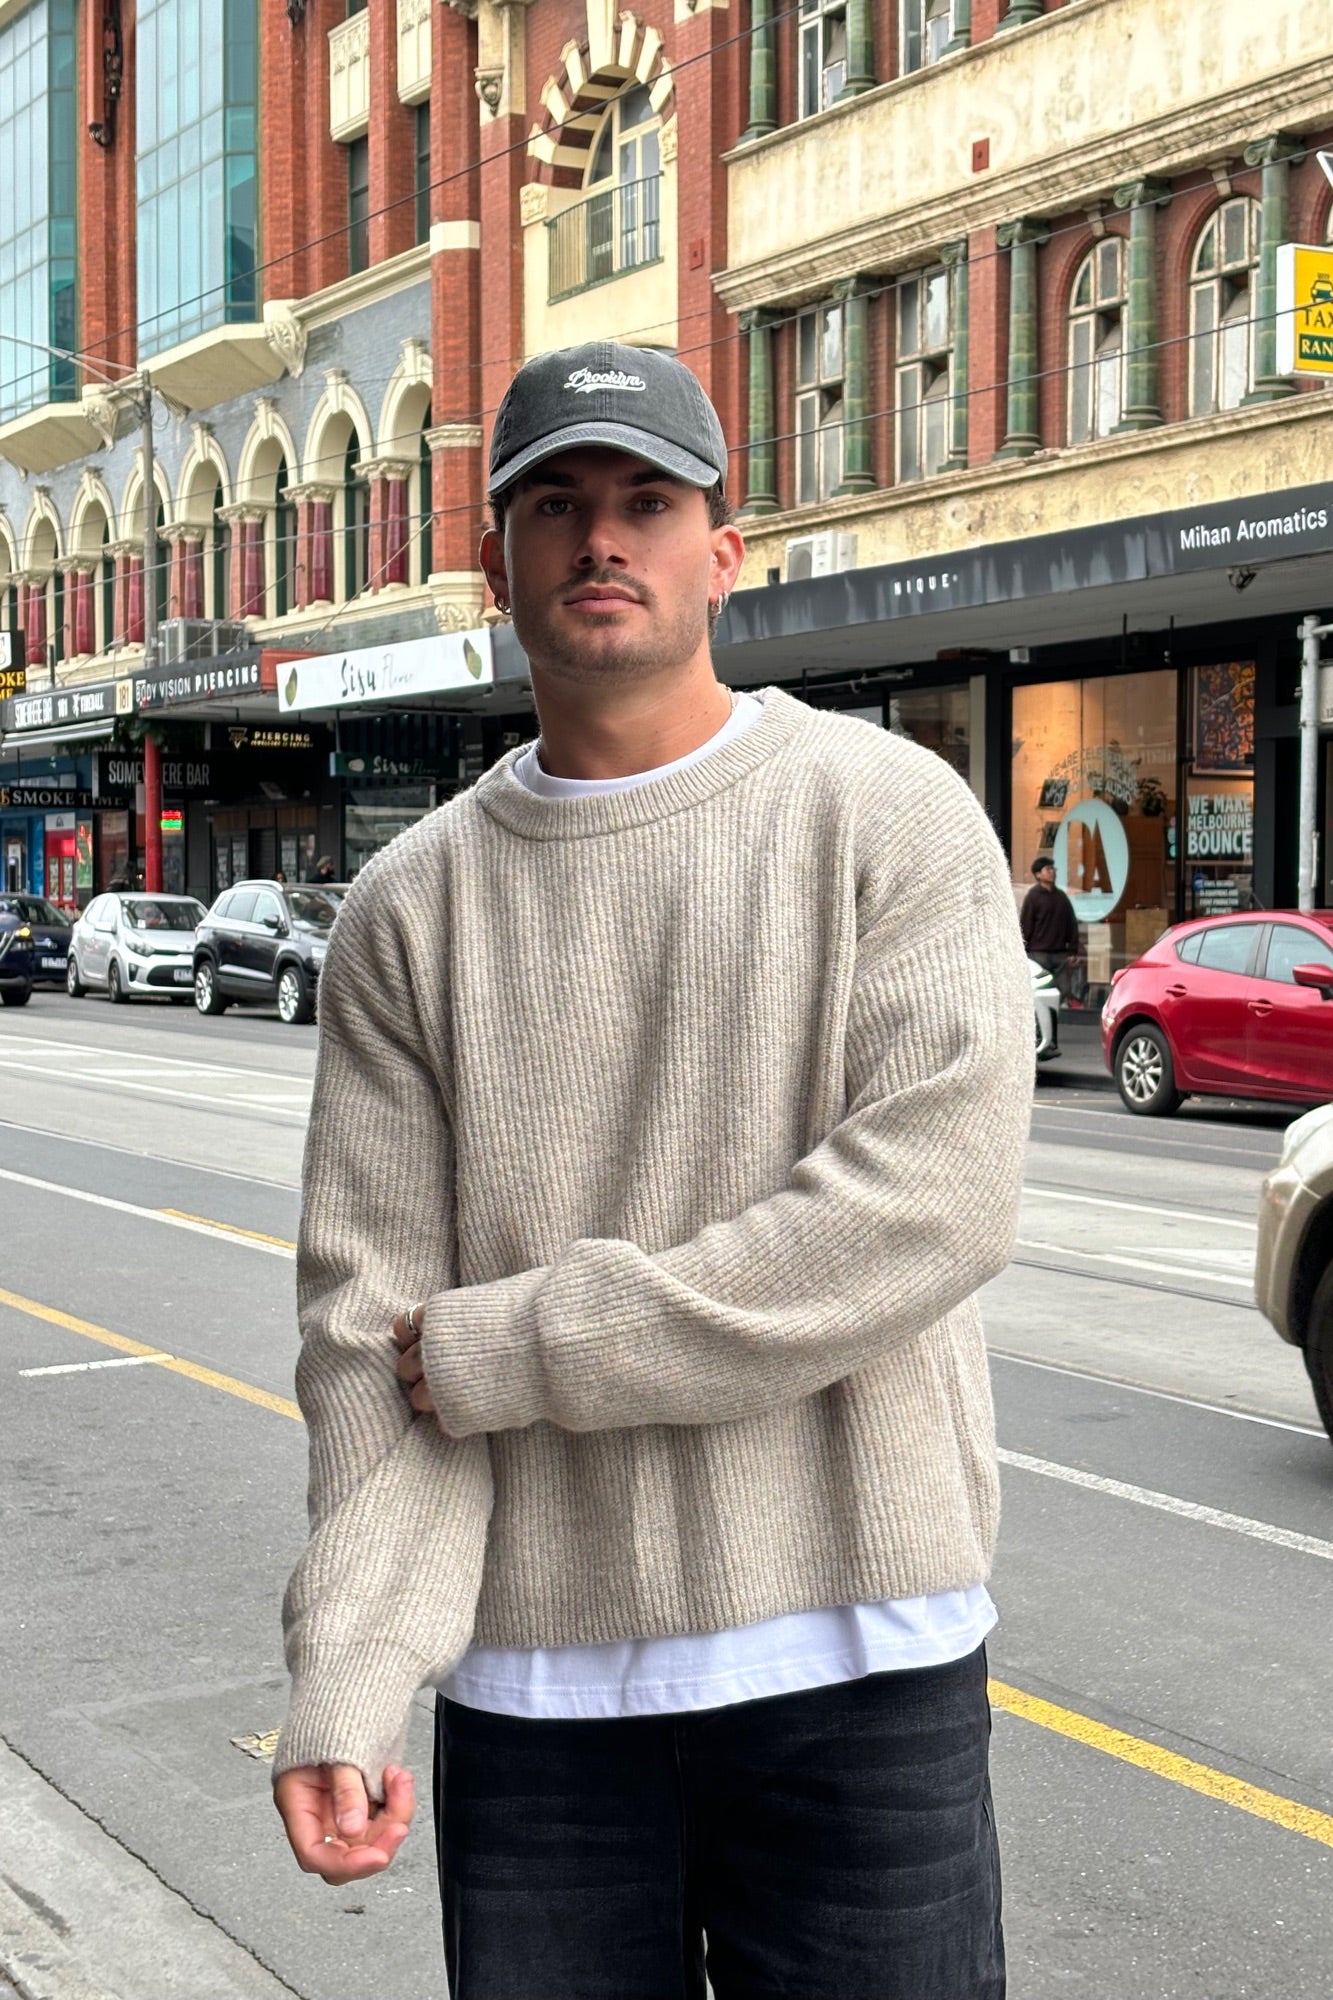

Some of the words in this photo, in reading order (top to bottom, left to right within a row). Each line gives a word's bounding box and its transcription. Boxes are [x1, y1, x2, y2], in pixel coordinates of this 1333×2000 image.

[564, 366, 646, 394] Brooklyn
[1180, 525, 1231, 551] Mihan
[1236, 507, 1328, 542] Aromatics
[160, 677, 191, 697] VISION
[195, 664, 258, 693] PIERCING
[340, 657, 377, 698] Sisu
[254, 731, 310, 742] PIERCING
[108, 760, 184, 785] SOMEERE
[186, 763, 210, 786] BAR
[12, 790, 75, 806] SMOKE
[1188, 794, 1209, 814] WE
[1213, 793, 1251, 813] MAKE
[1187, 813, 1252, 830] MELBOURNE
[1187, 830, 1253, 855] BOUNCE
